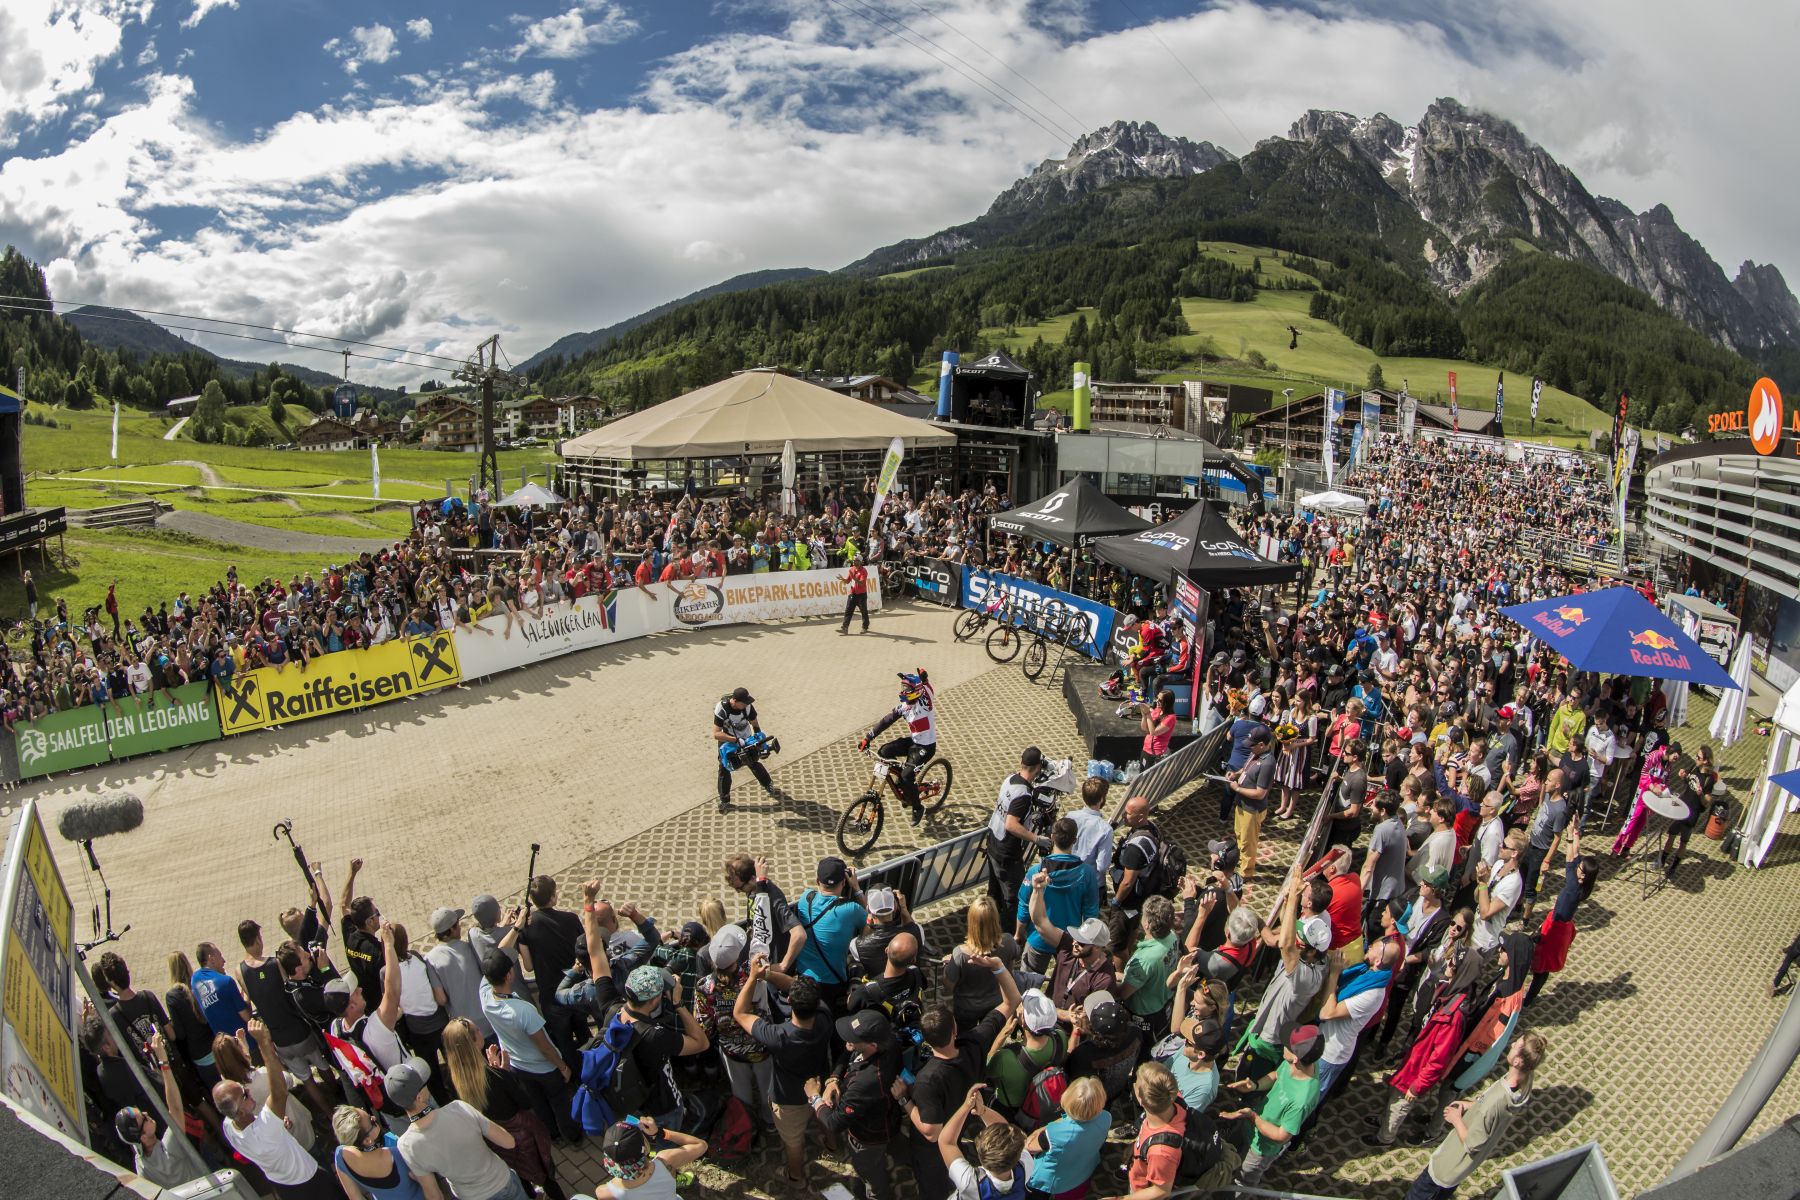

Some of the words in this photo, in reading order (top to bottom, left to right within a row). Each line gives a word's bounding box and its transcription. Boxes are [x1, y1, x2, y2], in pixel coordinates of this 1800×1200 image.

[1708, 410, 1744, 433] SPORT
[1016, 511, 1064, 523] SCOTT
[997, 521, 1025, 532] SCOTT
[1140, 531, 1190, 546] GoPro
[1200, 540, 1256, 557] GoPro
[674, 599, 720, 615] BIKEPARK
[1549, 619, 1576, 638] Bull
[1629, 648, 1661, 665] Red
[1661, 652, 1691, 671] Bull
[266, 671, 413, 721] Raiffeisen
[49, 715, 135, 753] SAALFELDEN
[138, 701, 210, 733] LEOGANG
